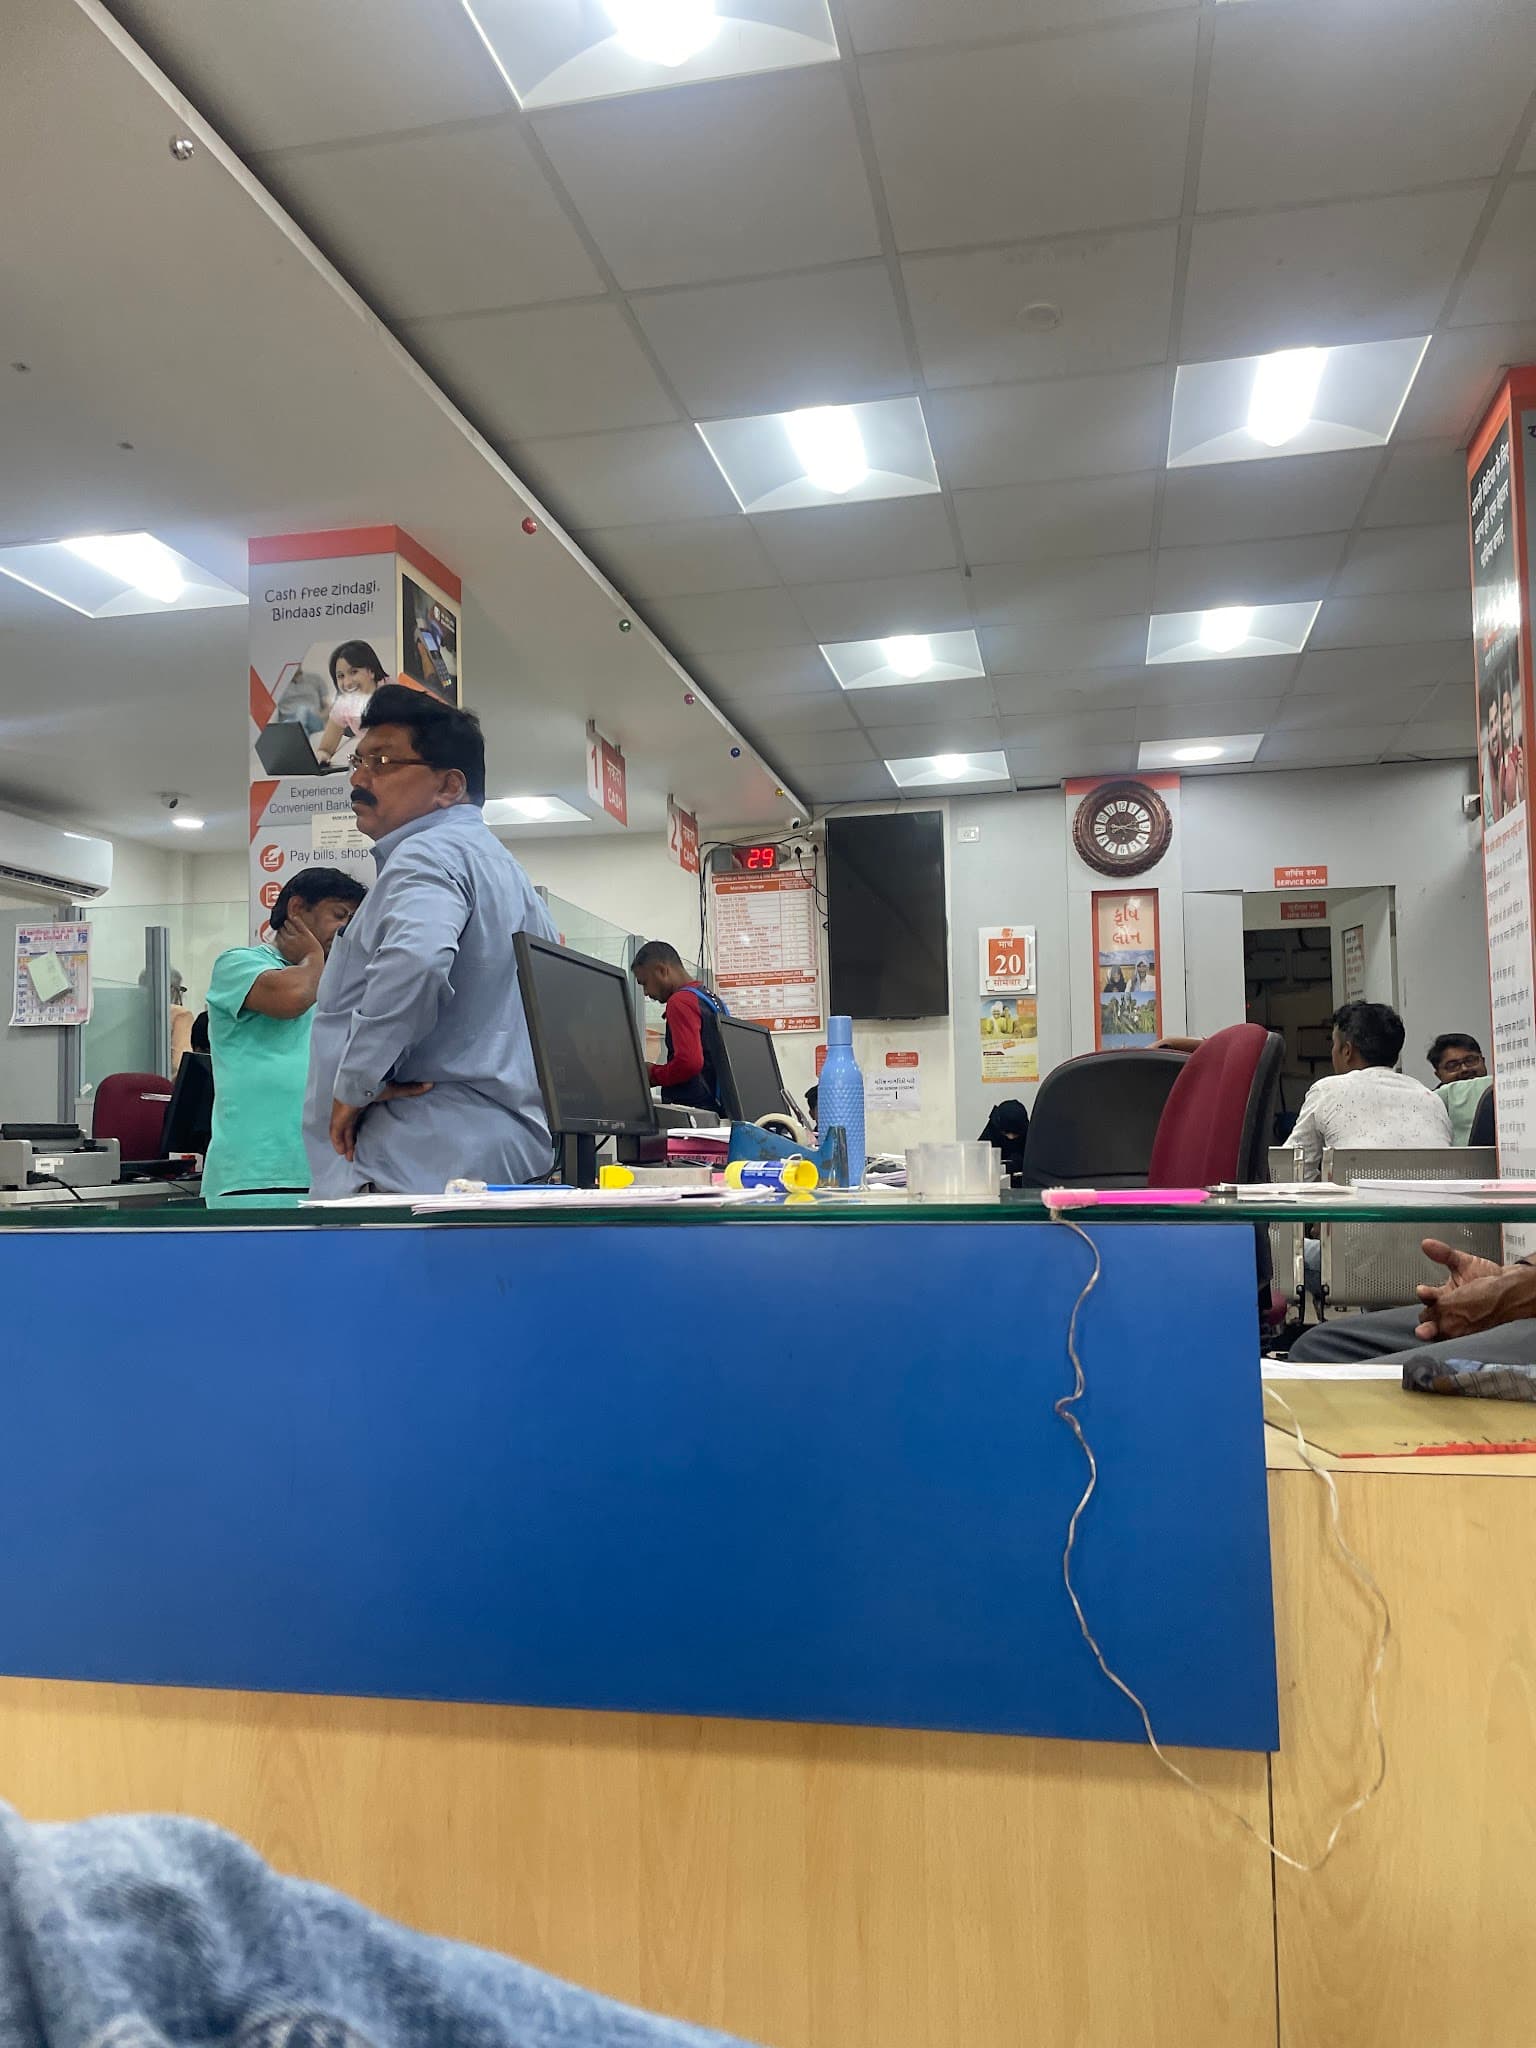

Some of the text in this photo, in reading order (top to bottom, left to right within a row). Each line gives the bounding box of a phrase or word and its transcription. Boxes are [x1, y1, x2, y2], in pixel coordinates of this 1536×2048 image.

[265, 580, 380, 603] Cash free zindagi.
[272, 601, 374, 622] Bindaas zindagi!
[591, 745, 598, 789] 1
[290, 786, 344, 799] Experience
[269, 802, 323, 814] Convenient
[671, 814, 678, 852] 2
[290, 848, 369, 864] Pay bills, shop
[747, 847, 774, 869] 29
[1276, 878, 1326, 887] SERVICE ROOM
[994, 954, 1022, 974] 20
